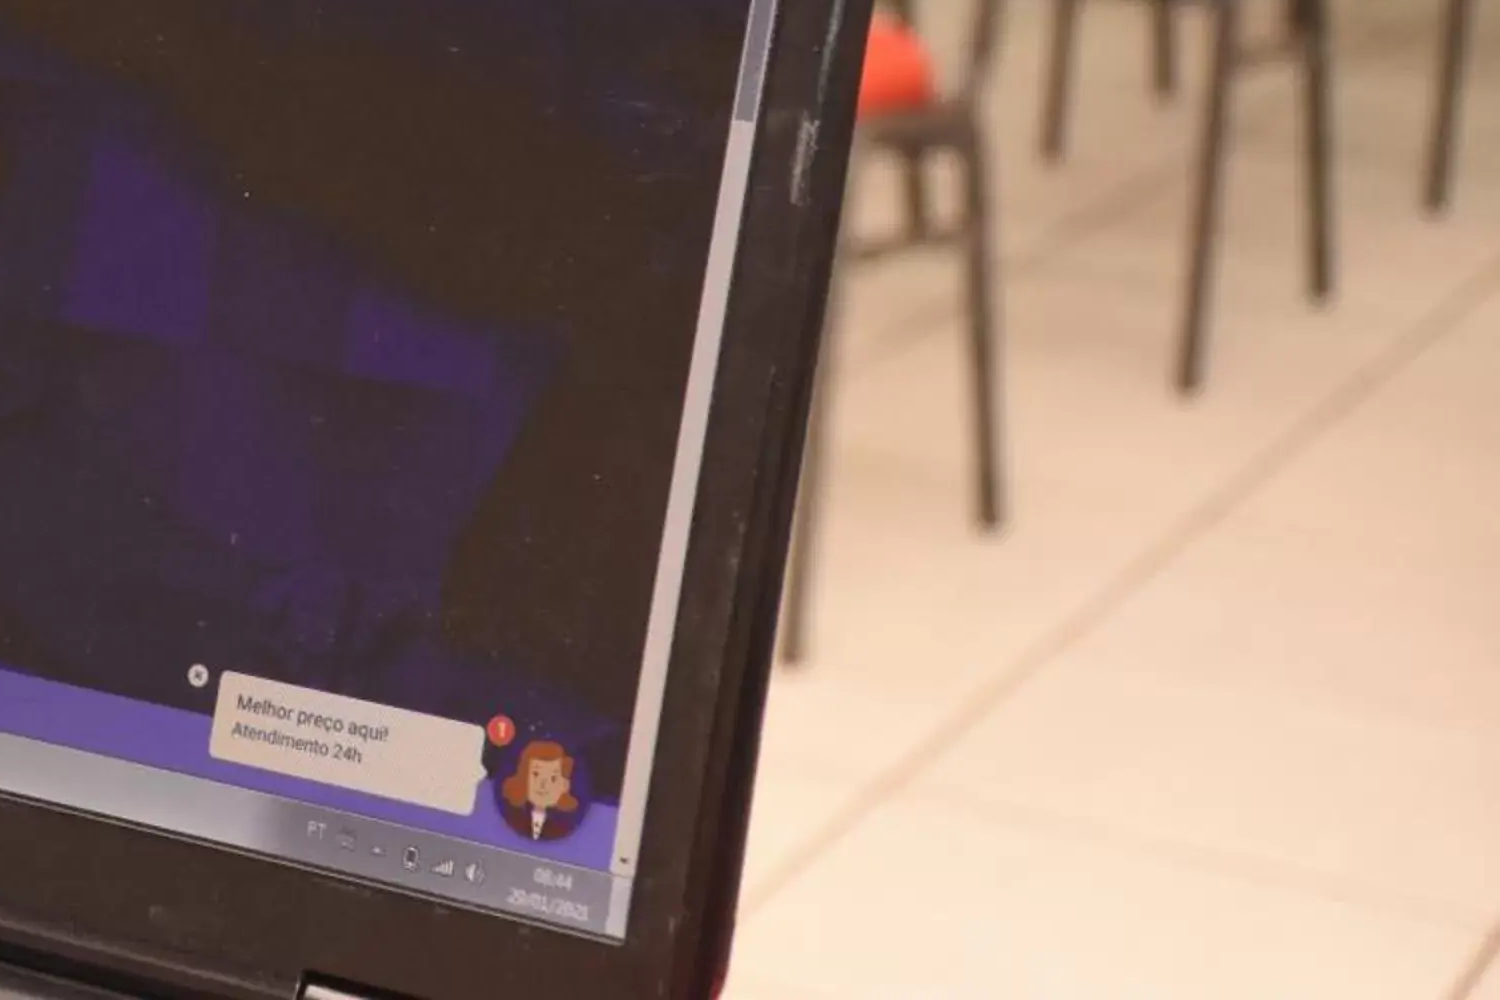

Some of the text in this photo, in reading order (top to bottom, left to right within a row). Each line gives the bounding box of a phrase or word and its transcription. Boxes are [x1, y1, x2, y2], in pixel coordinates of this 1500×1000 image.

[236, 693, 389, 744] Melhor preço aqui!
[230, 720, 363, 765] Atendimento 24h
[306, 820, 327, 840] PT
